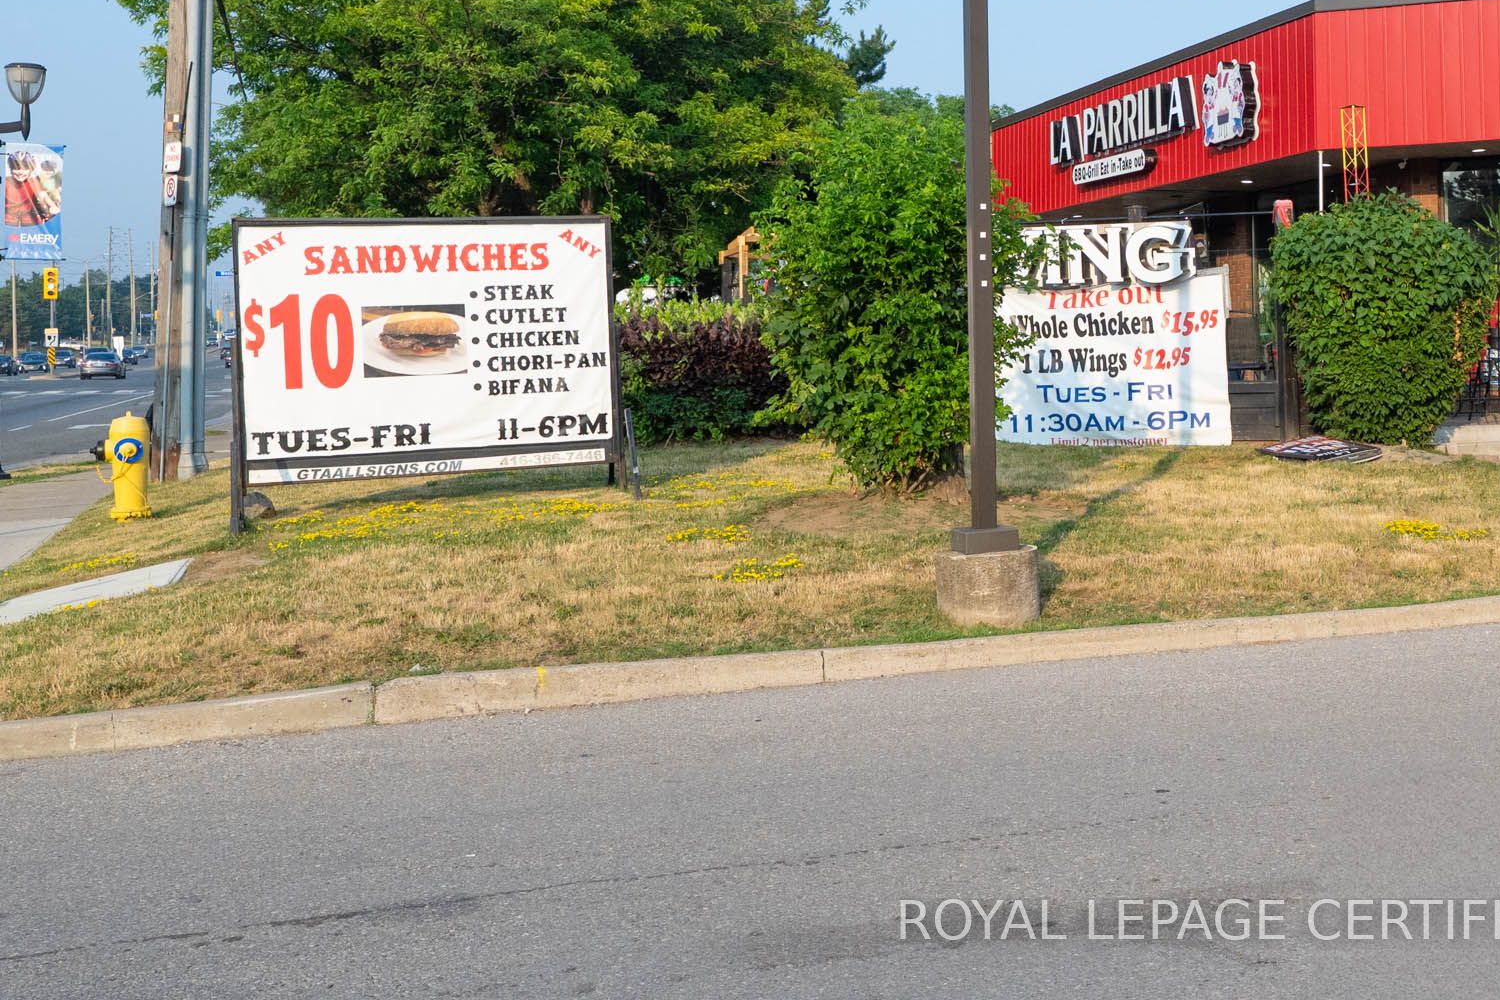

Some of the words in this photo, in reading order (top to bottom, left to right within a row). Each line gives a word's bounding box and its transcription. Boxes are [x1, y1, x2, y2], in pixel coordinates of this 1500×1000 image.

[1050, 115, 1082, 165] LA
[1083, 76, 1196, 153] PARRILLA
[1074, 164, 1100, 182] BBQ-Grill
[1100, 162, 1109, 176] Eat
[1134, 153, 1144, 168] out
[20, 233, 58, 245] EMERY
[242, 231, 286, 266] ANY
[558, 228, 602, 258] ANY
[303, 243, 550, 276] SANDWICHES
[483, 284, 555, 302] STEAK
[485, 307, 567, 325] CUTLET
[1010, 313, 1068, 339] Whole
[1073, 311, 1155, 338] Chicken
[1160, 310, 1219, 336] $15.95
[244, 293, 355, 390] $10
[486, 330, 580, 348] CHICKEN
[487, 352, 607, 372] CHORI-PAN
[1022, 354, 1032, 374] 1
[1038, 349, 1064, 374] LB
[1068, 348, 1127, 378] Wings
[1133, 346, 1192, 370] $12.95
[488, 376, 570, 396] BIFANA
[251, 422, 431, 455] TUES-FRI
[497, 412, 609, 441] 11-6PM
[1146, 410, 1211, 431] 6PM
[296, 460, 463, 481] GTAALLSIGNS.COM
